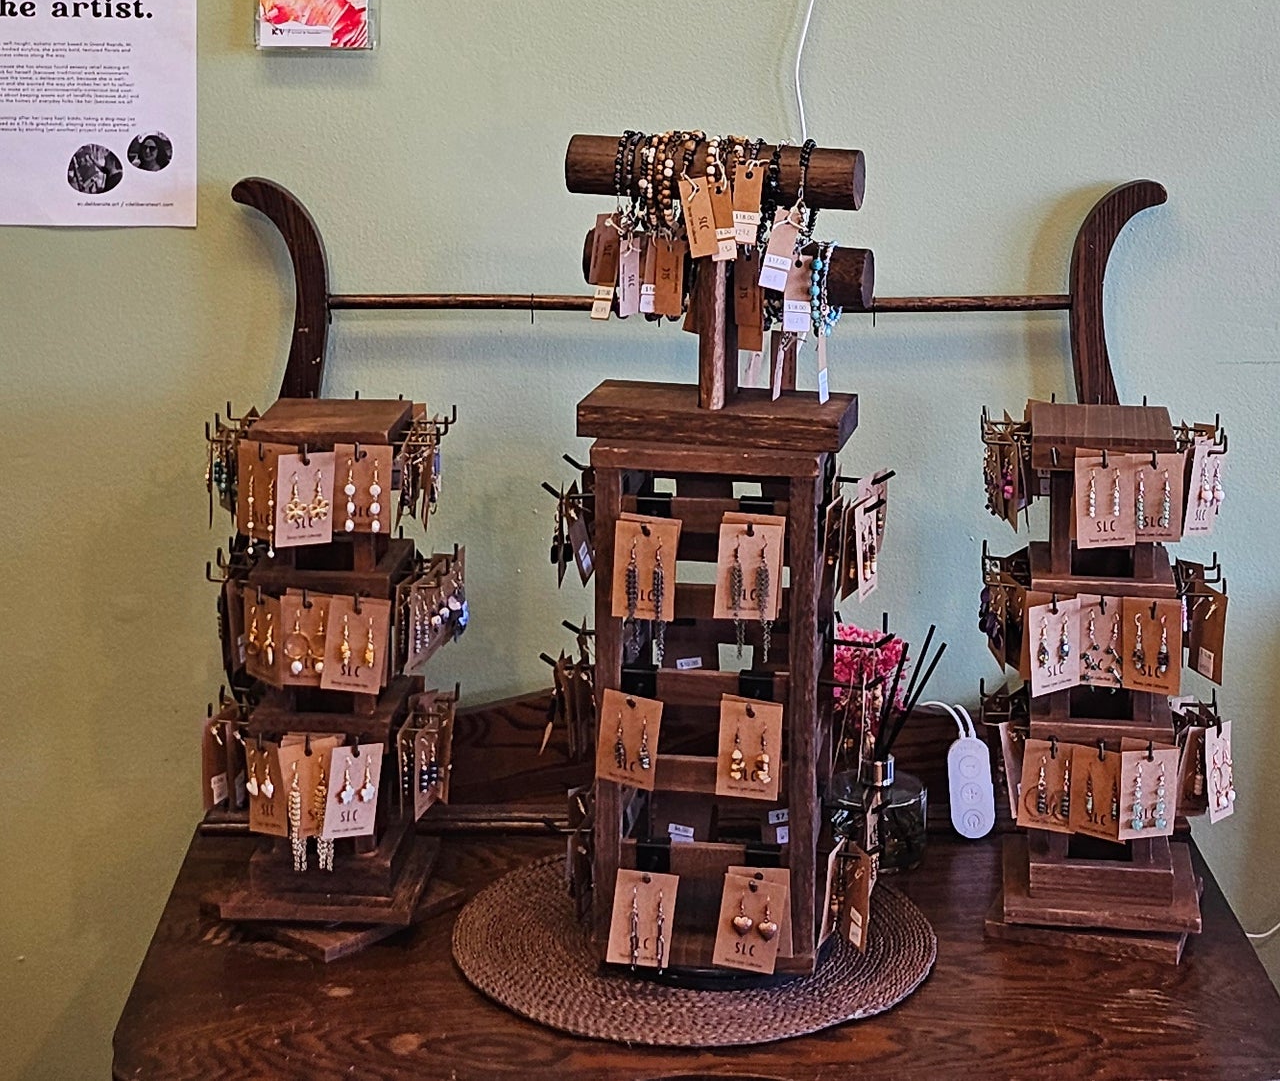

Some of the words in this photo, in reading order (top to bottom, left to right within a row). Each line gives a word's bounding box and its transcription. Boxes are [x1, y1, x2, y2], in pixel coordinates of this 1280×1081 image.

[1096, 520, 1116, 533] SLC
[341, 664, 360, 678] SLC
[1047, 664, 1064, 678] SLC
[1141, 664, 1161, 679] SLC
[340, 809, 358, 823] SLC
[735, 941, 756, 957] SLC
